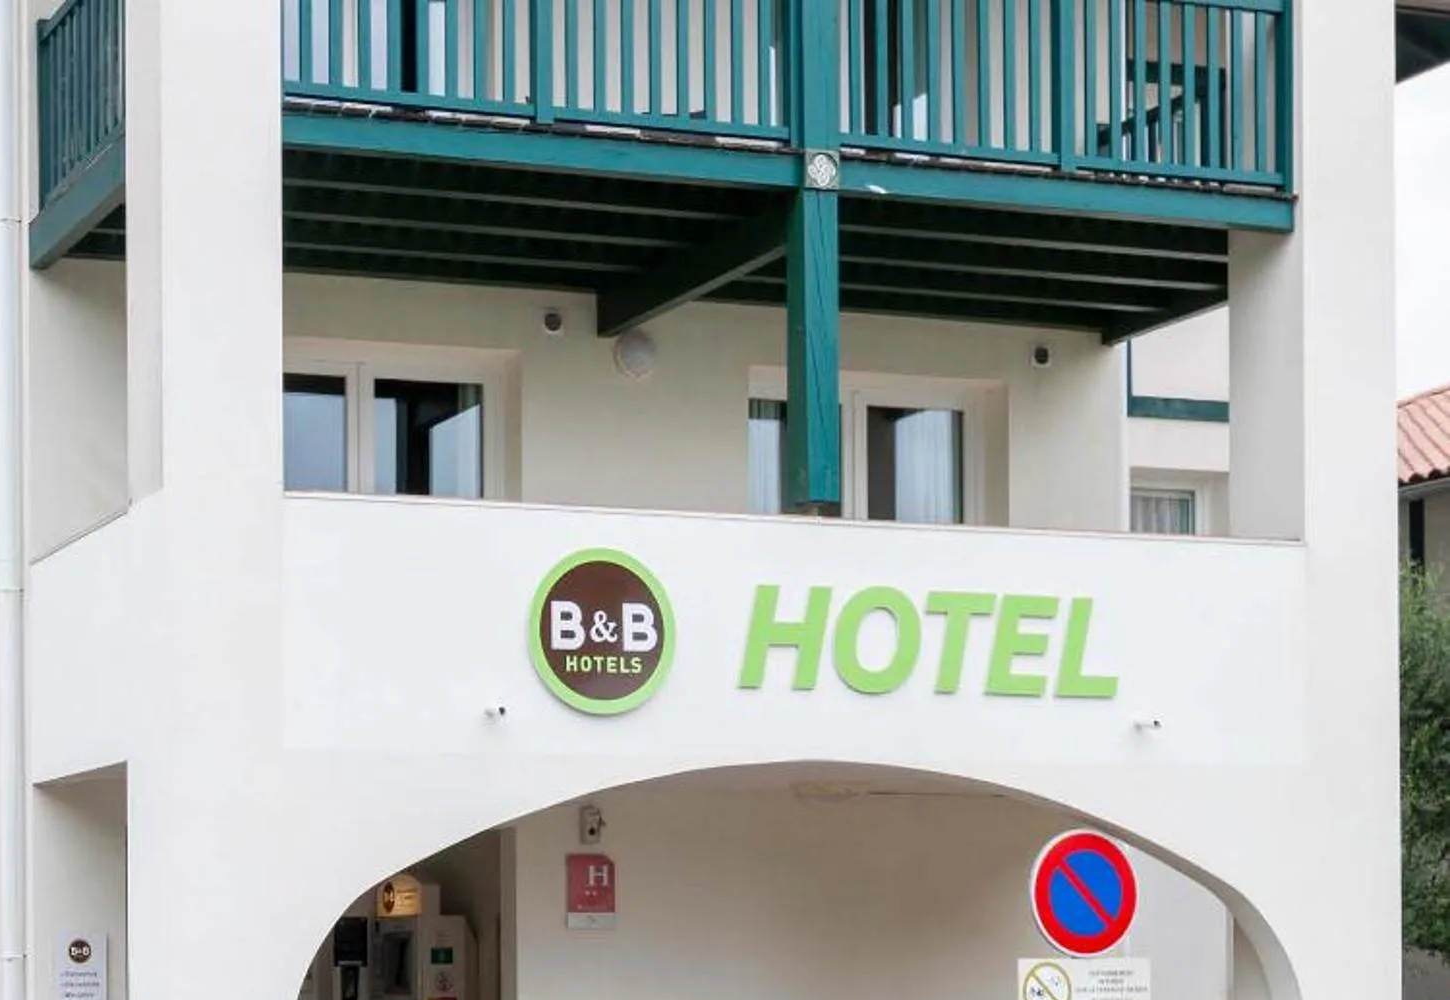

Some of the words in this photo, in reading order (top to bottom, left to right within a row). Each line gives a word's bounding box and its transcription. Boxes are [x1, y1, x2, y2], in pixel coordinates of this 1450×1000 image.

[550, 600, 658, 652] B&B
[737, 584, 1119, 699] HOTEL
[565, 655, 643, 674] HOTELS
[588, 864, 608, 886] H
